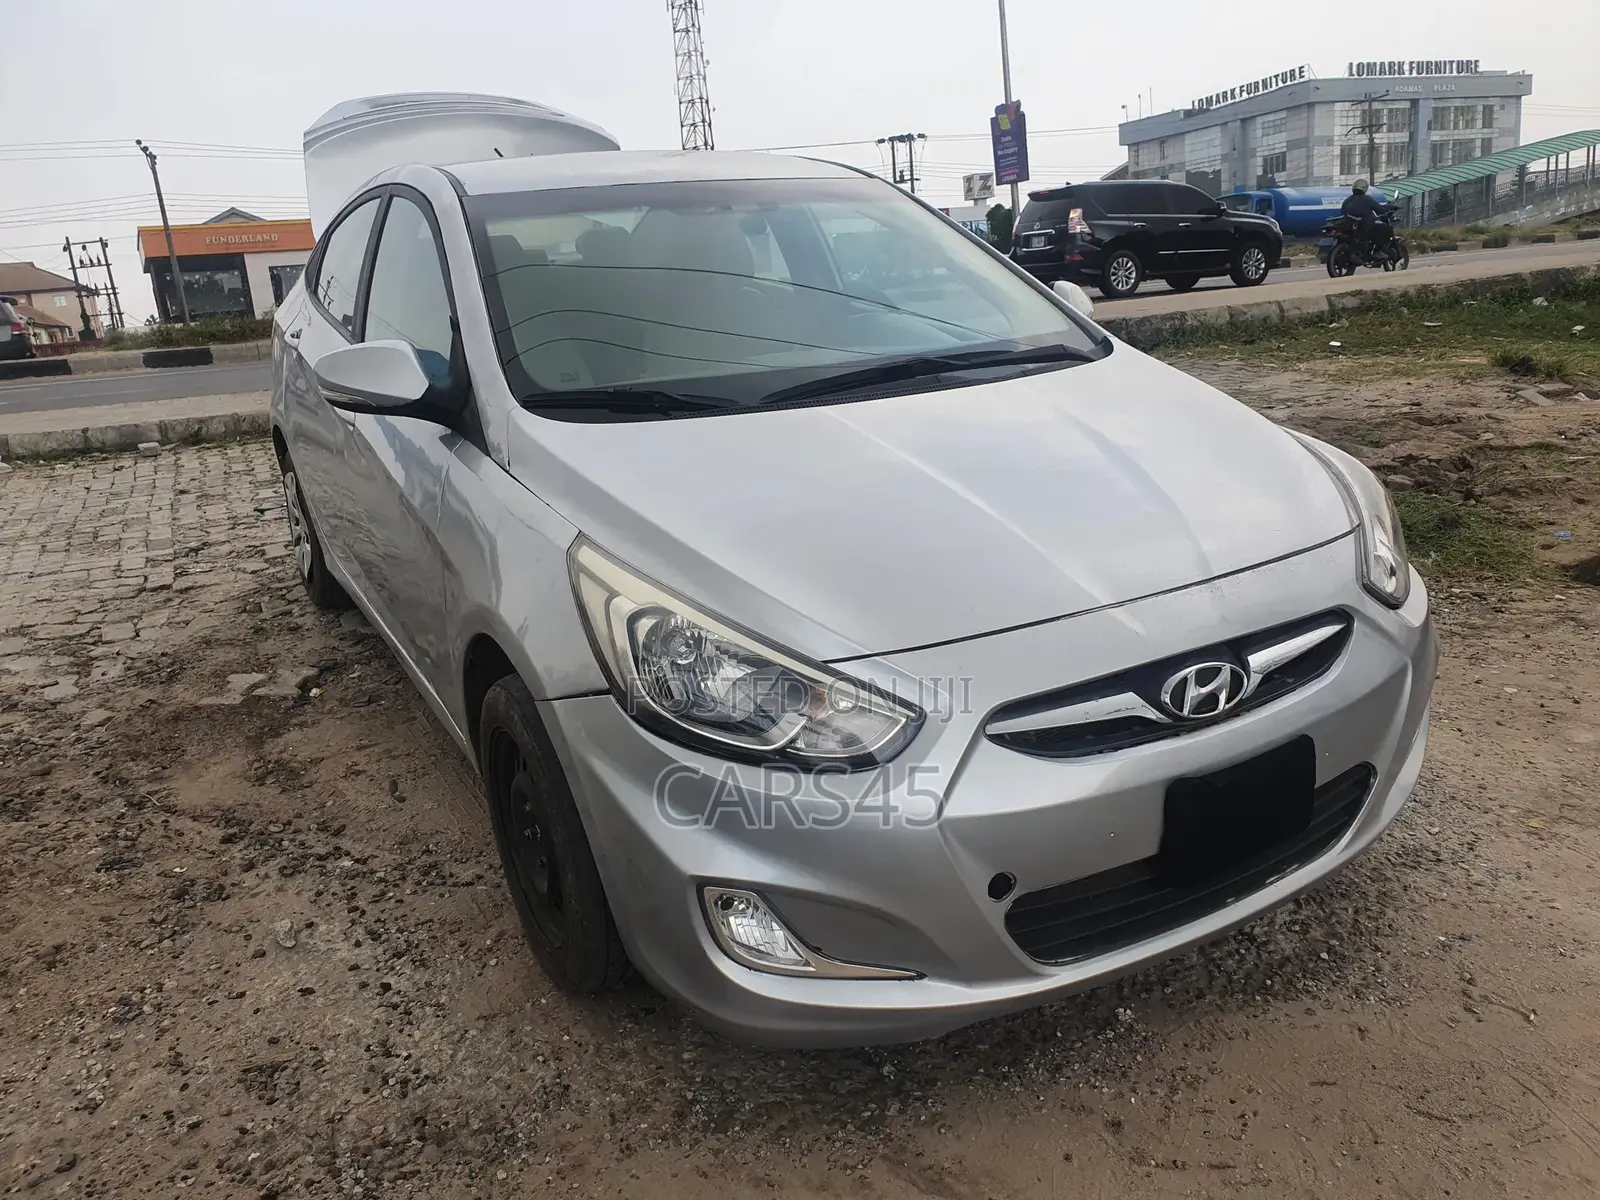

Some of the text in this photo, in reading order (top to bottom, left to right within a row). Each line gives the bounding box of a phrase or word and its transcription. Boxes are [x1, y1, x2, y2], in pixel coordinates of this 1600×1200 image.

[1348, 59, 1480, 77] LOMARK FURNITURE
[1191, 65, 1305, 110] LOMARK FURNITURE
[1394, 83, 1456, 93] ADAMAS PLAZA
[205, 233, 278, 245] FUNDERLAND
